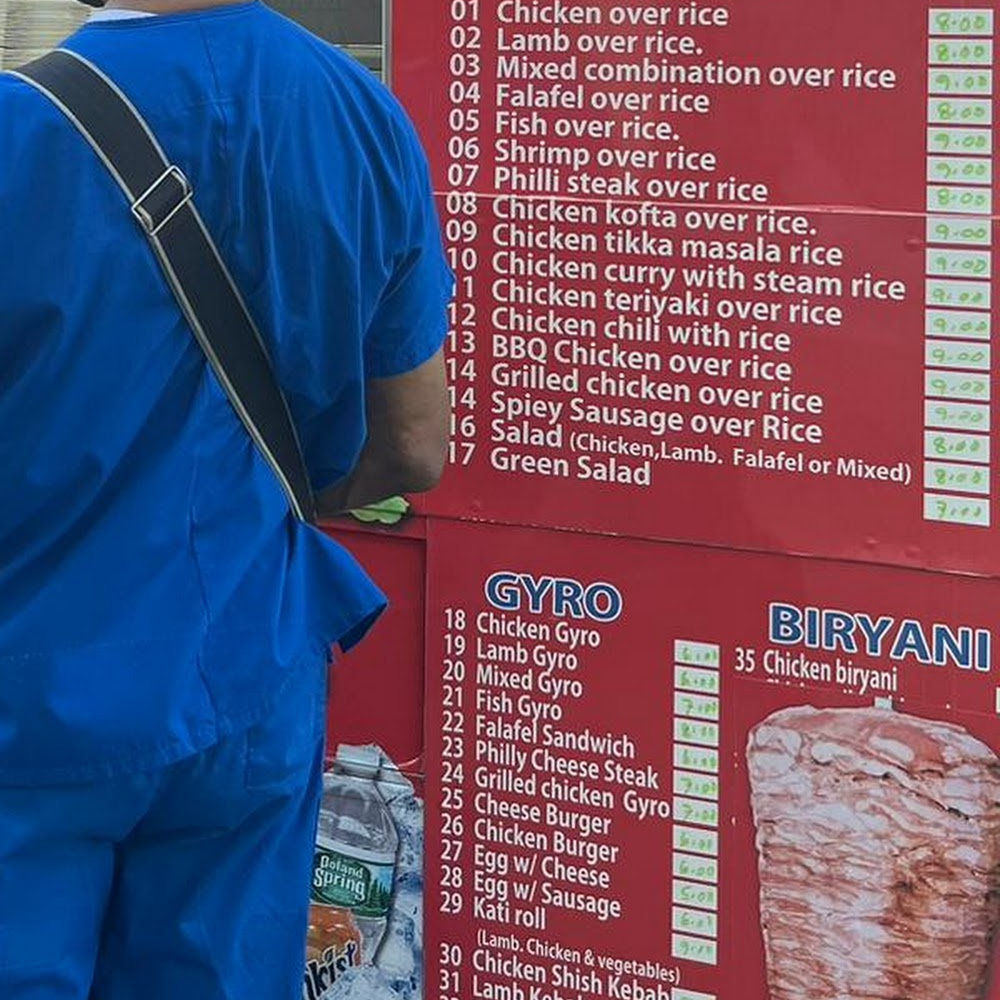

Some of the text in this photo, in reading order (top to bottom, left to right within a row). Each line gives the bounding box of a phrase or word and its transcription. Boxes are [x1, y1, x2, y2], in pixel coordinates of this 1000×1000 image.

[497, 0, 601, 24] Chicken
[609, 5, 671, 25] over
[678, 2, 729, 26] rice
[450, 26, 703, 55] 02 Lamb over rice.
[450, 54, 896, 88] 03 Mixed combination over rice
[449, 81, 710, 113] 04 Falafel over rice
[449, 108, 680, 141] 05 Fish over rice.
[448, 163, 768, 202] 07 Philli steak over rice
[448, 441, 651, 486] 17 Green Salad
[484, 571, 623, 622] GYRO
[444, 608, 601, 649] 18 Chicken Gyro
[768, 602, 991, 672] BIRYANI
[444, 634, 578, 672] 19 Lamb Gyro
[735, 647, 897, 694] 35 Chicken biryani
[442, 710, 635, 759] 22 Falafel Sandwich
[313, 867, 366, 902] Spring
[439, 891, 546, 930] 29 Kati roll
[477, 928, 681, 985] (Lamb. Chicken & vegetables)
